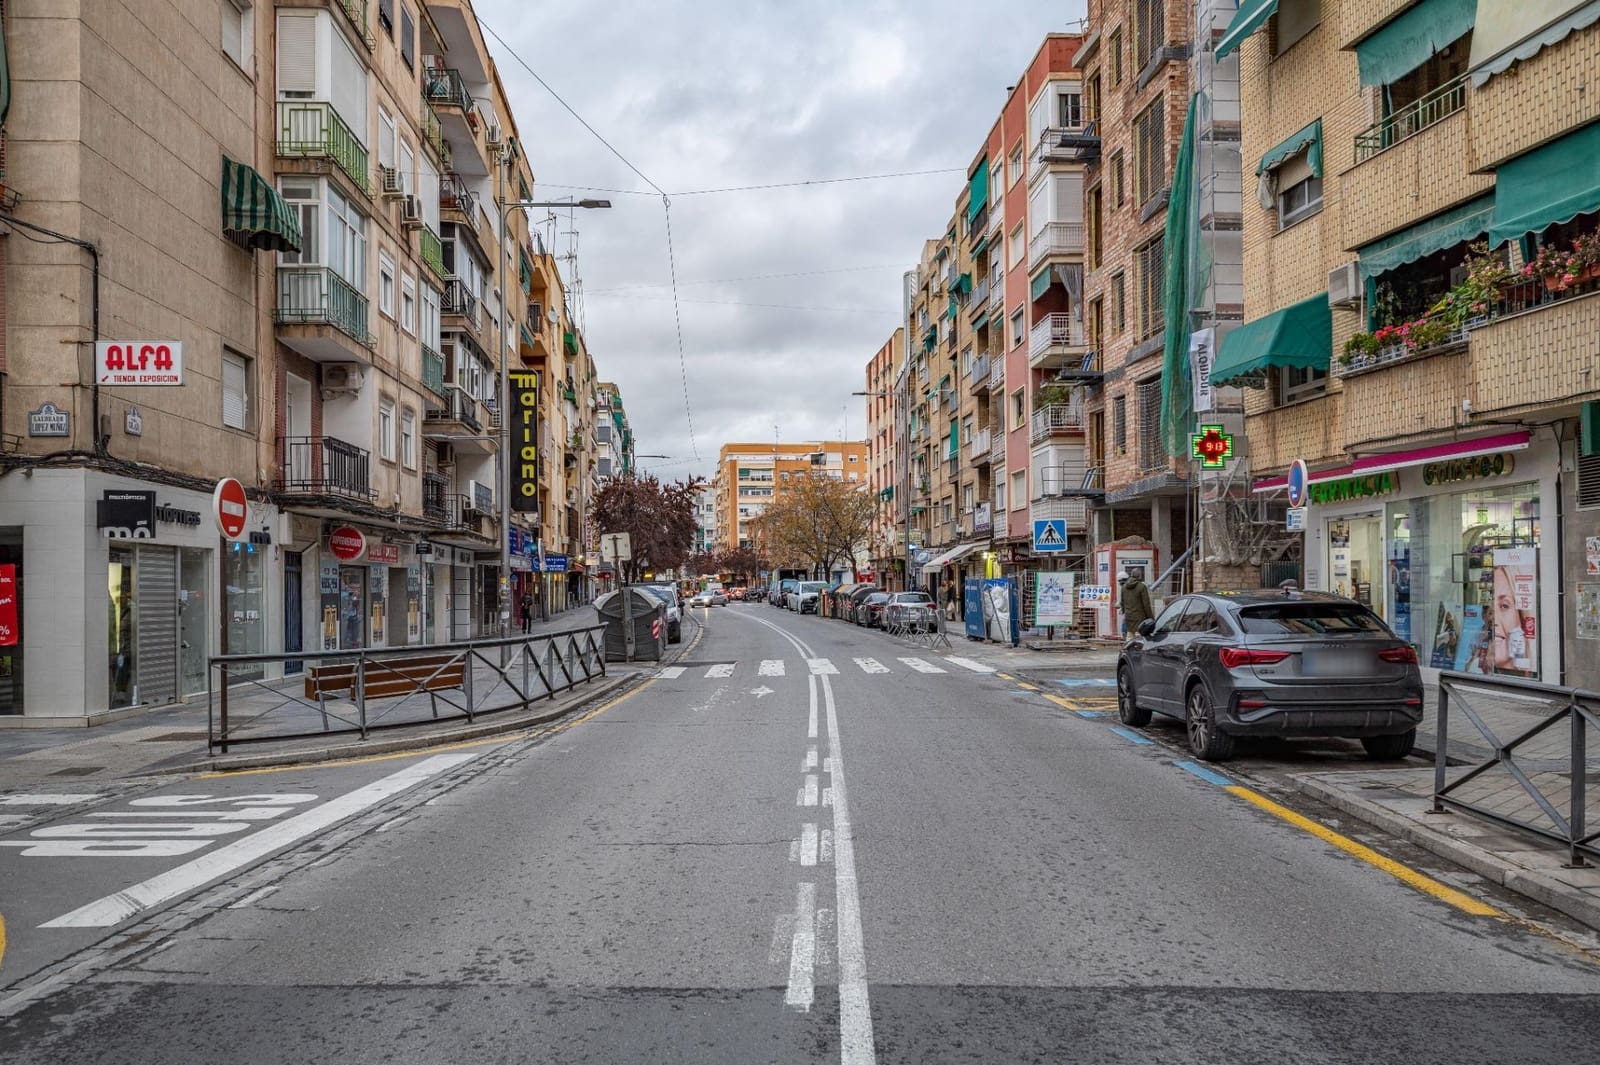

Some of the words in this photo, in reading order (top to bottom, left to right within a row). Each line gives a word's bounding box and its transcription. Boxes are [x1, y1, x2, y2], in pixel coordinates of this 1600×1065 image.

[105, 345, 173, 370] ALFA
[113, 375, 136, 383] TIENDA
[139, 375, 179, 383] EXPOSICION
[509, 374, 536, 497] mariano
[1311, 472, 1392, 505] FARMACIA
[0, 793, 319, 857] STOP
